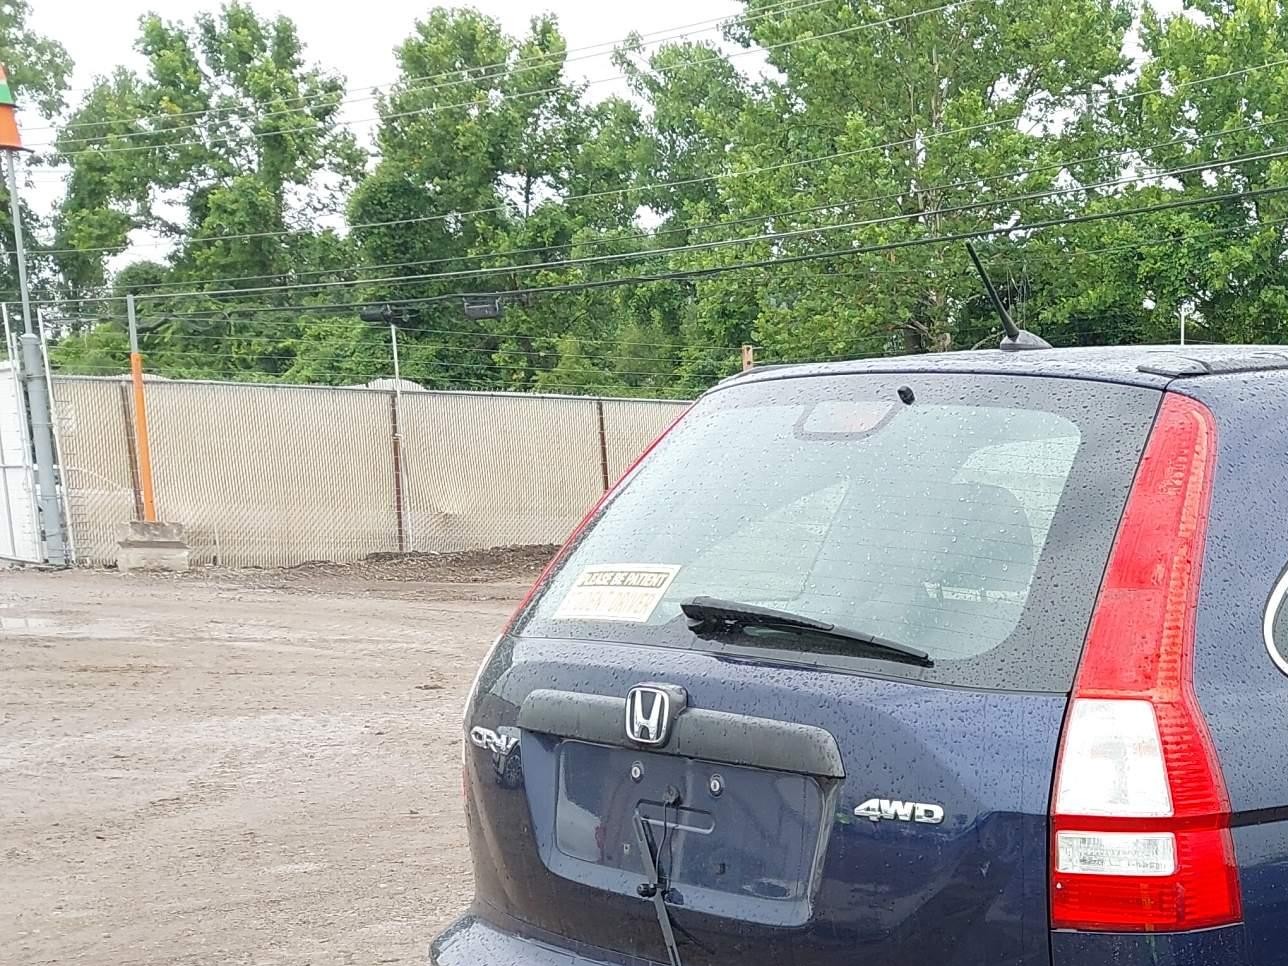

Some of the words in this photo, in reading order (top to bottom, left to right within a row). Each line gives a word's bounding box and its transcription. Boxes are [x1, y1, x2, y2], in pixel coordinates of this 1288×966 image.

[611, 573, 627, 586] BE
[625, 572, 668, 587] PATIENT
[854, 798, 944, 824] 4WD
